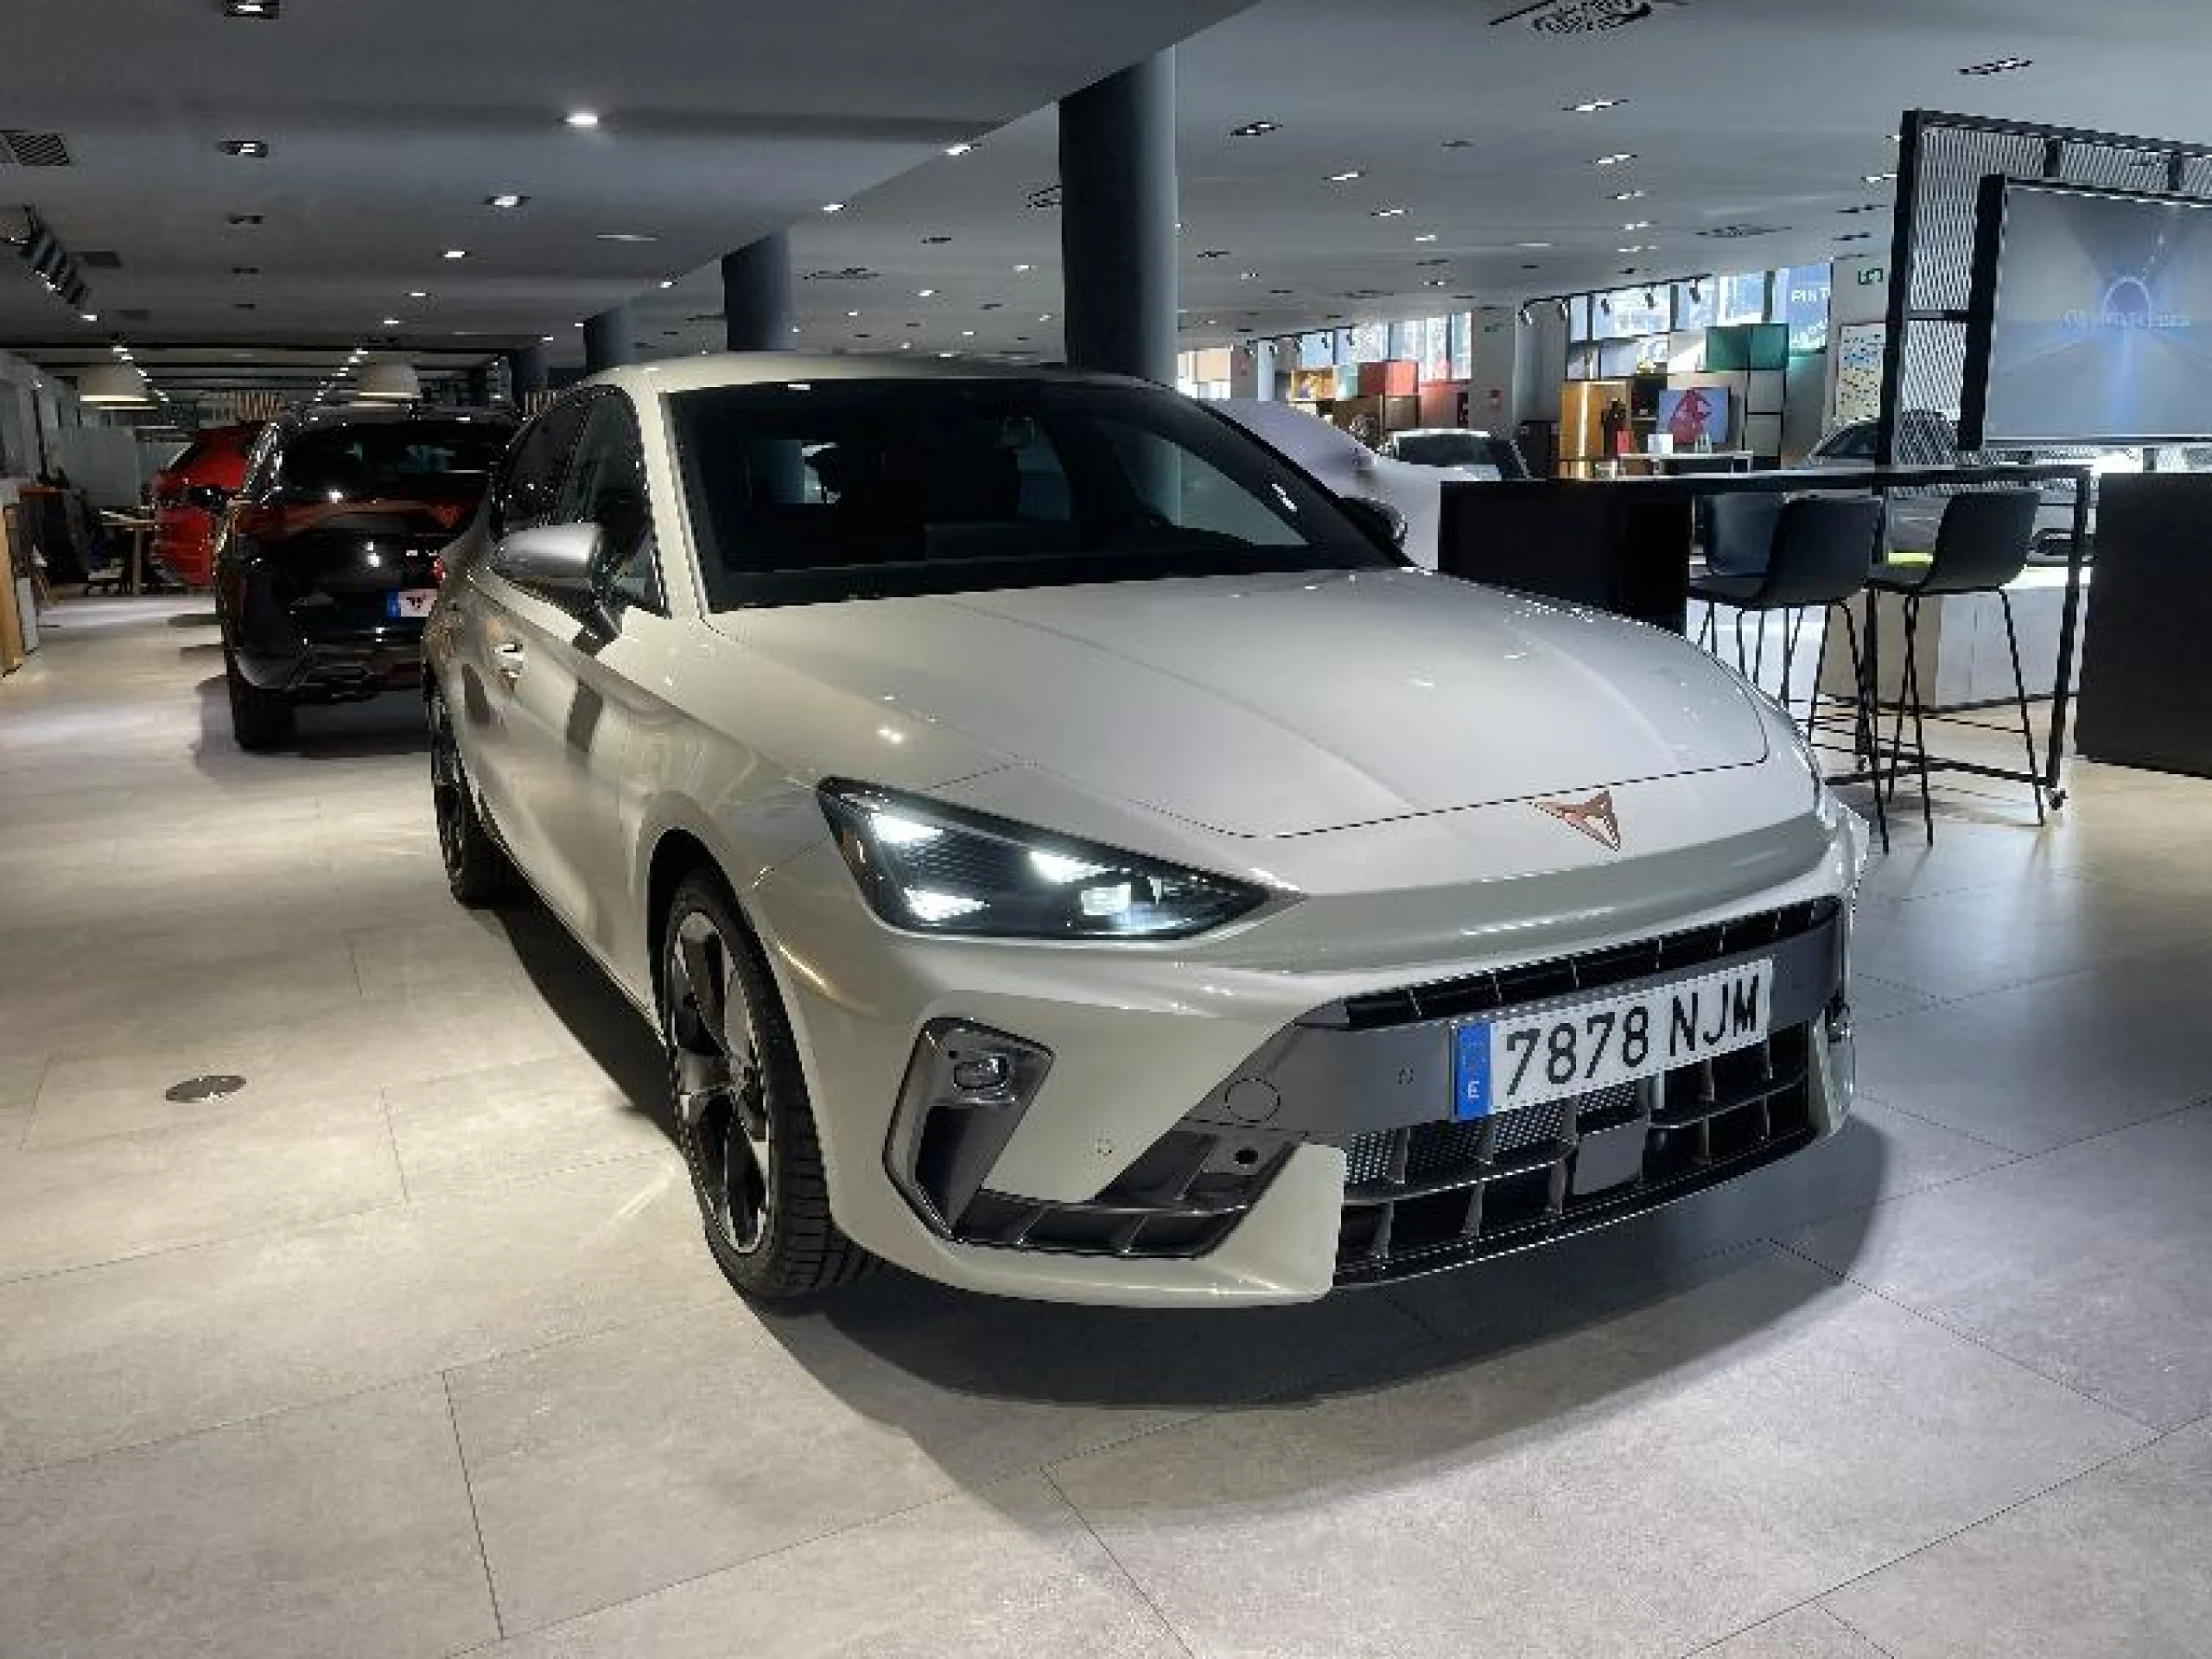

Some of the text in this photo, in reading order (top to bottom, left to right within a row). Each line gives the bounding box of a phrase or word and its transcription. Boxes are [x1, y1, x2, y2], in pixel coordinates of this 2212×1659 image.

[1467, 974, 1761, 1100] E 7878 NJM
